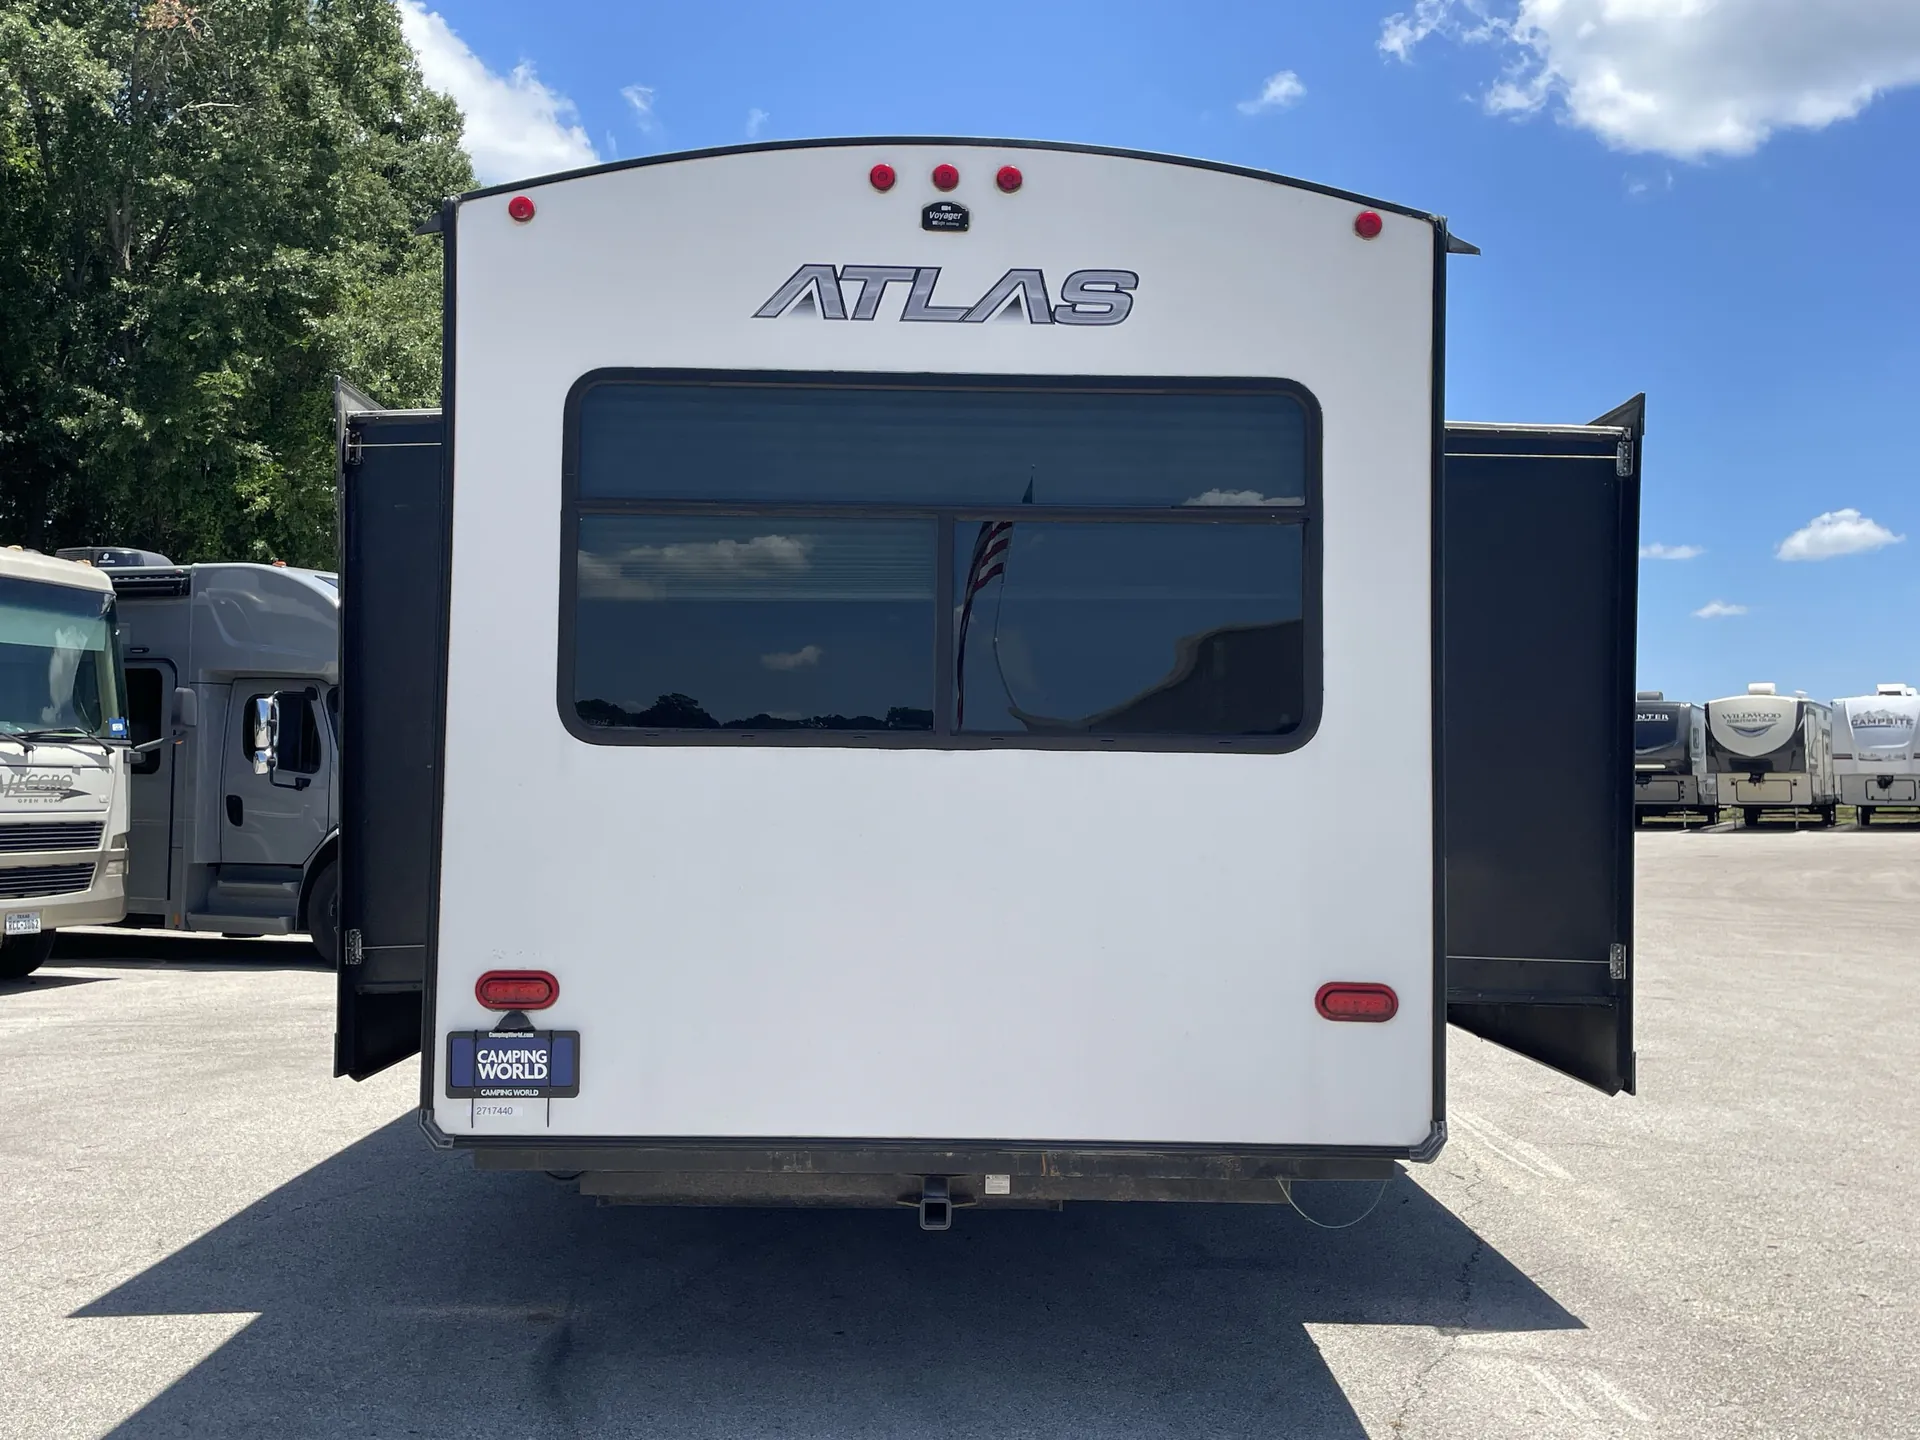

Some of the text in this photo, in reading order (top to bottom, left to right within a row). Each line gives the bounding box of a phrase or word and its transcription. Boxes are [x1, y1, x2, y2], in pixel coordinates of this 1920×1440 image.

[929, 211, 962, 220] Voyager
[751, 263, 1140, 326] ATLAS
[1721, 711, 1782, 719] WILDWOOD
[1851, 717, 1914, 726] CAMPSITE
[488, 1031, 535, 1039] CampingWorld.com
[477, 1049, 548, 1064] CAMPING
[480, 1089, 540, 1097] CAMPING WORLD
[476, 1106, 513, 1115] 2717440
